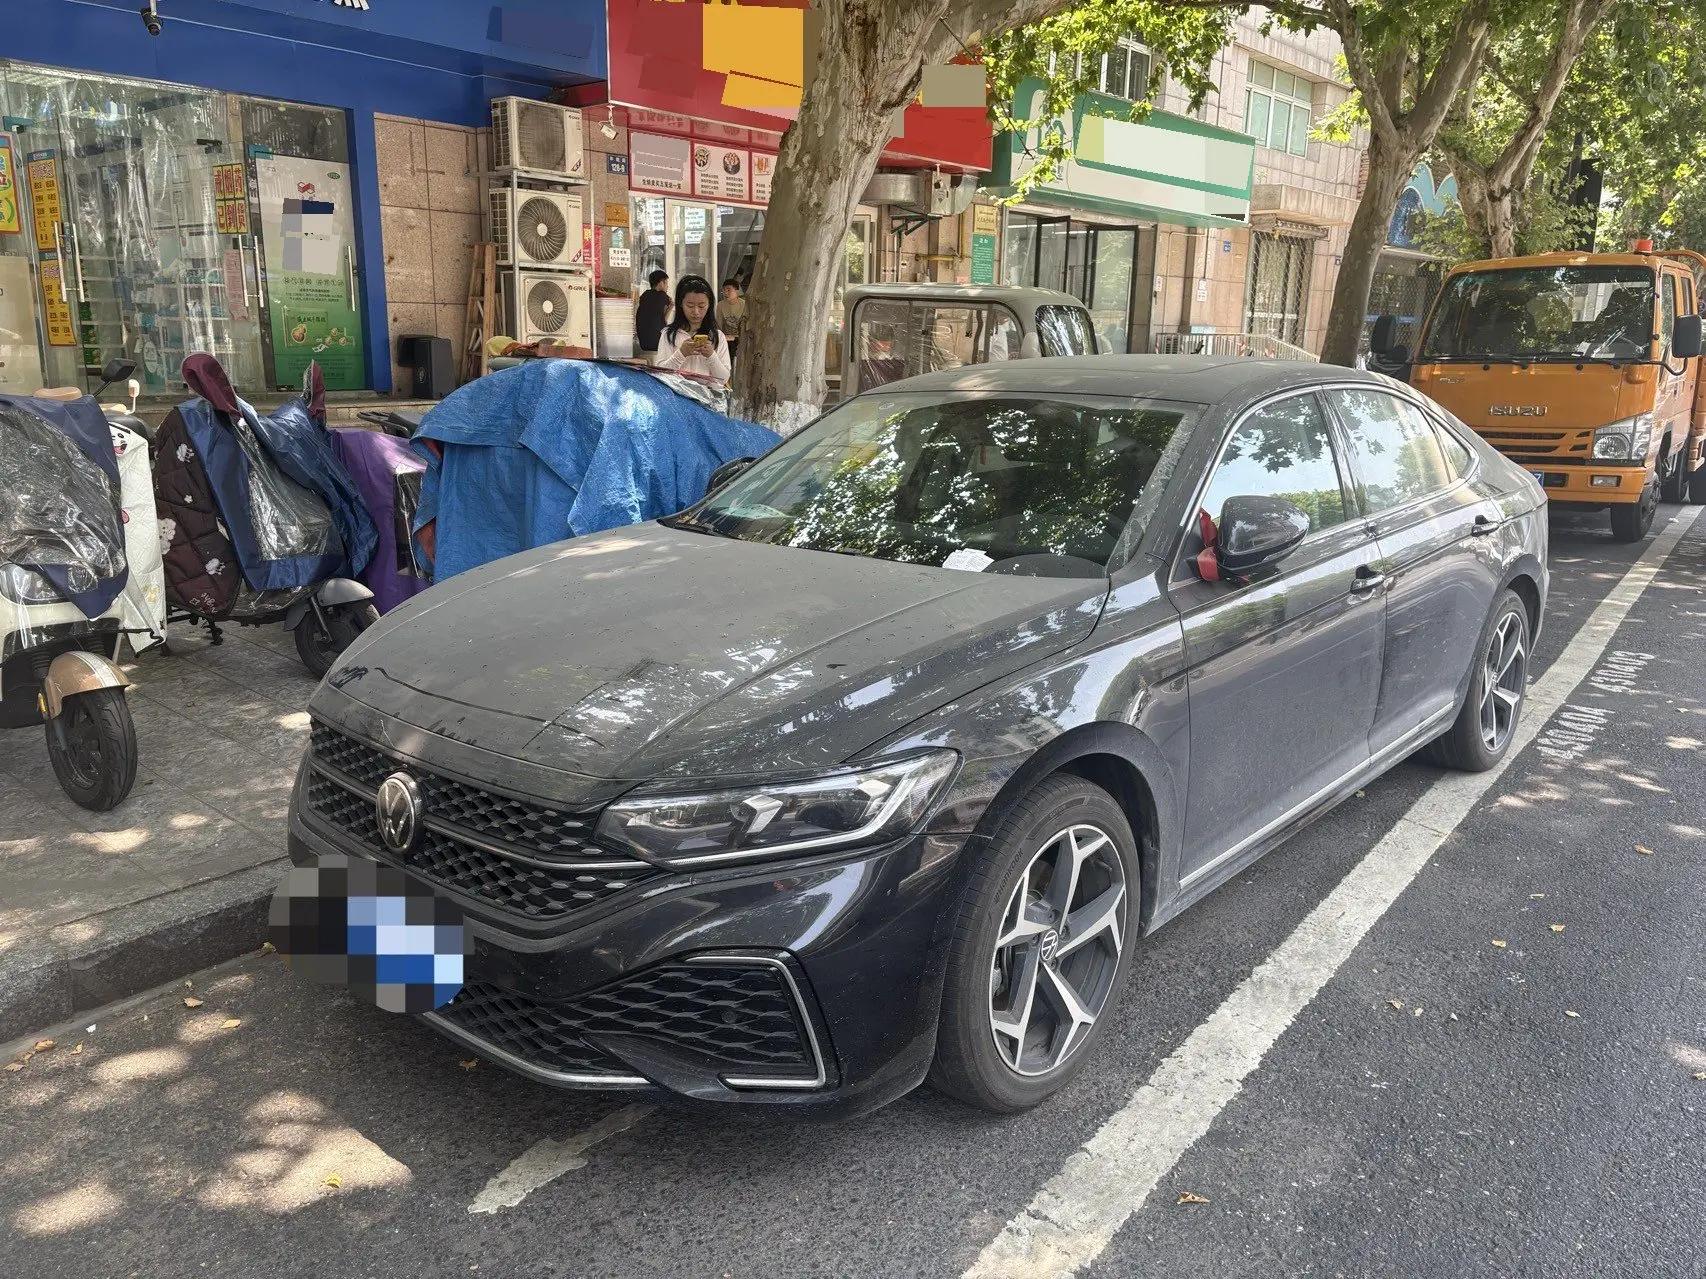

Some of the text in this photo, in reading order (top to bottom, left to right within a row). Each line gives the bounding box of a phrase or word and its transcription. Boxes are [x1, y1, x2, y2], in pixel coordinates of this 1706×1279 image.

[214, 168, 243, 194] 戒烟药
[216, 202, 246, 229] 已到货
[1489, 405, 1548, 416] ISUZU
